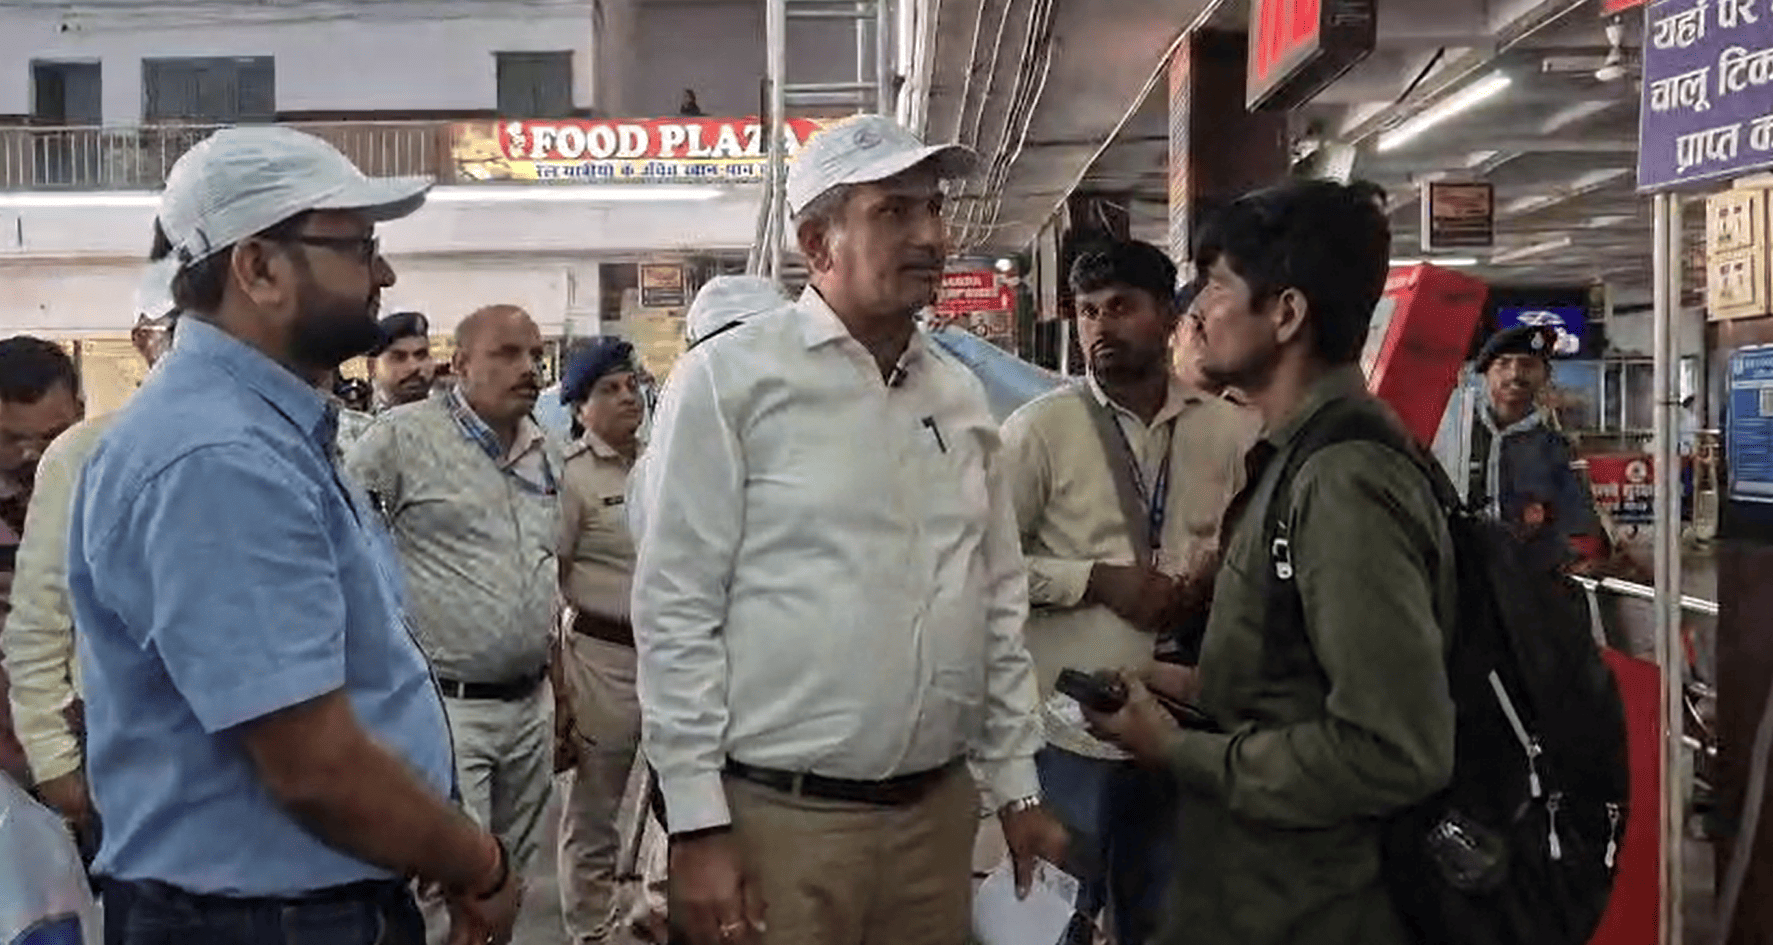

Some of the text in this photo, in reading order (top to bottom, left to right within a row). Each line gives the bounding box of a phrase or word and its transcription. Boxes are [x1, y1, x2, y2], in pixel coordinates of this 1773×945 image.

[1650, 66, 1712, 113] चालू
[529, 124, 649, 159] FOOD
[1676, 122, 1743, 175] प्राप्त
